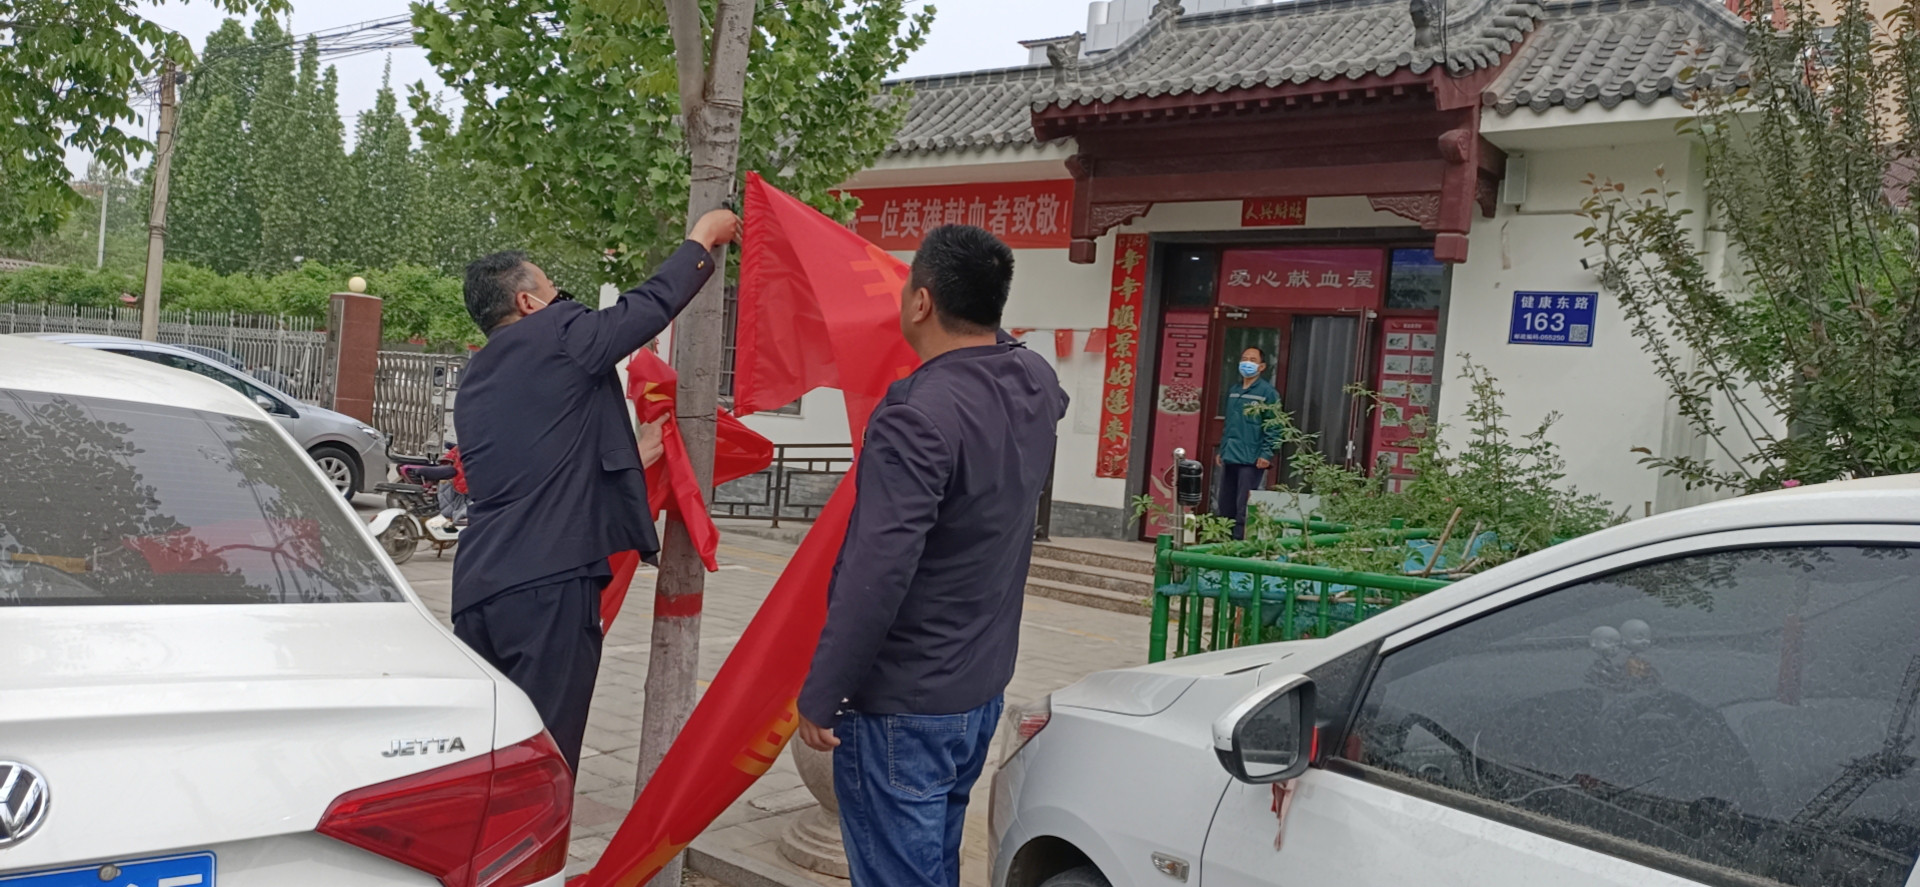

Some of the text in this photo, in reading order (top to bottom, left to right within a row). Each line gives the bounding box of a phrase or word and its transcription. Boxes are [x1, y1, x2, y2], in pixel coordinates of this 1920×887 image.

[1227, 269, 1375, 288] 爱心献血屋
[1521, 296, 1589, 310] 健康东路
[1523, 312, 1565, 332] 163
[381, 736, 466, 758] JETTA
